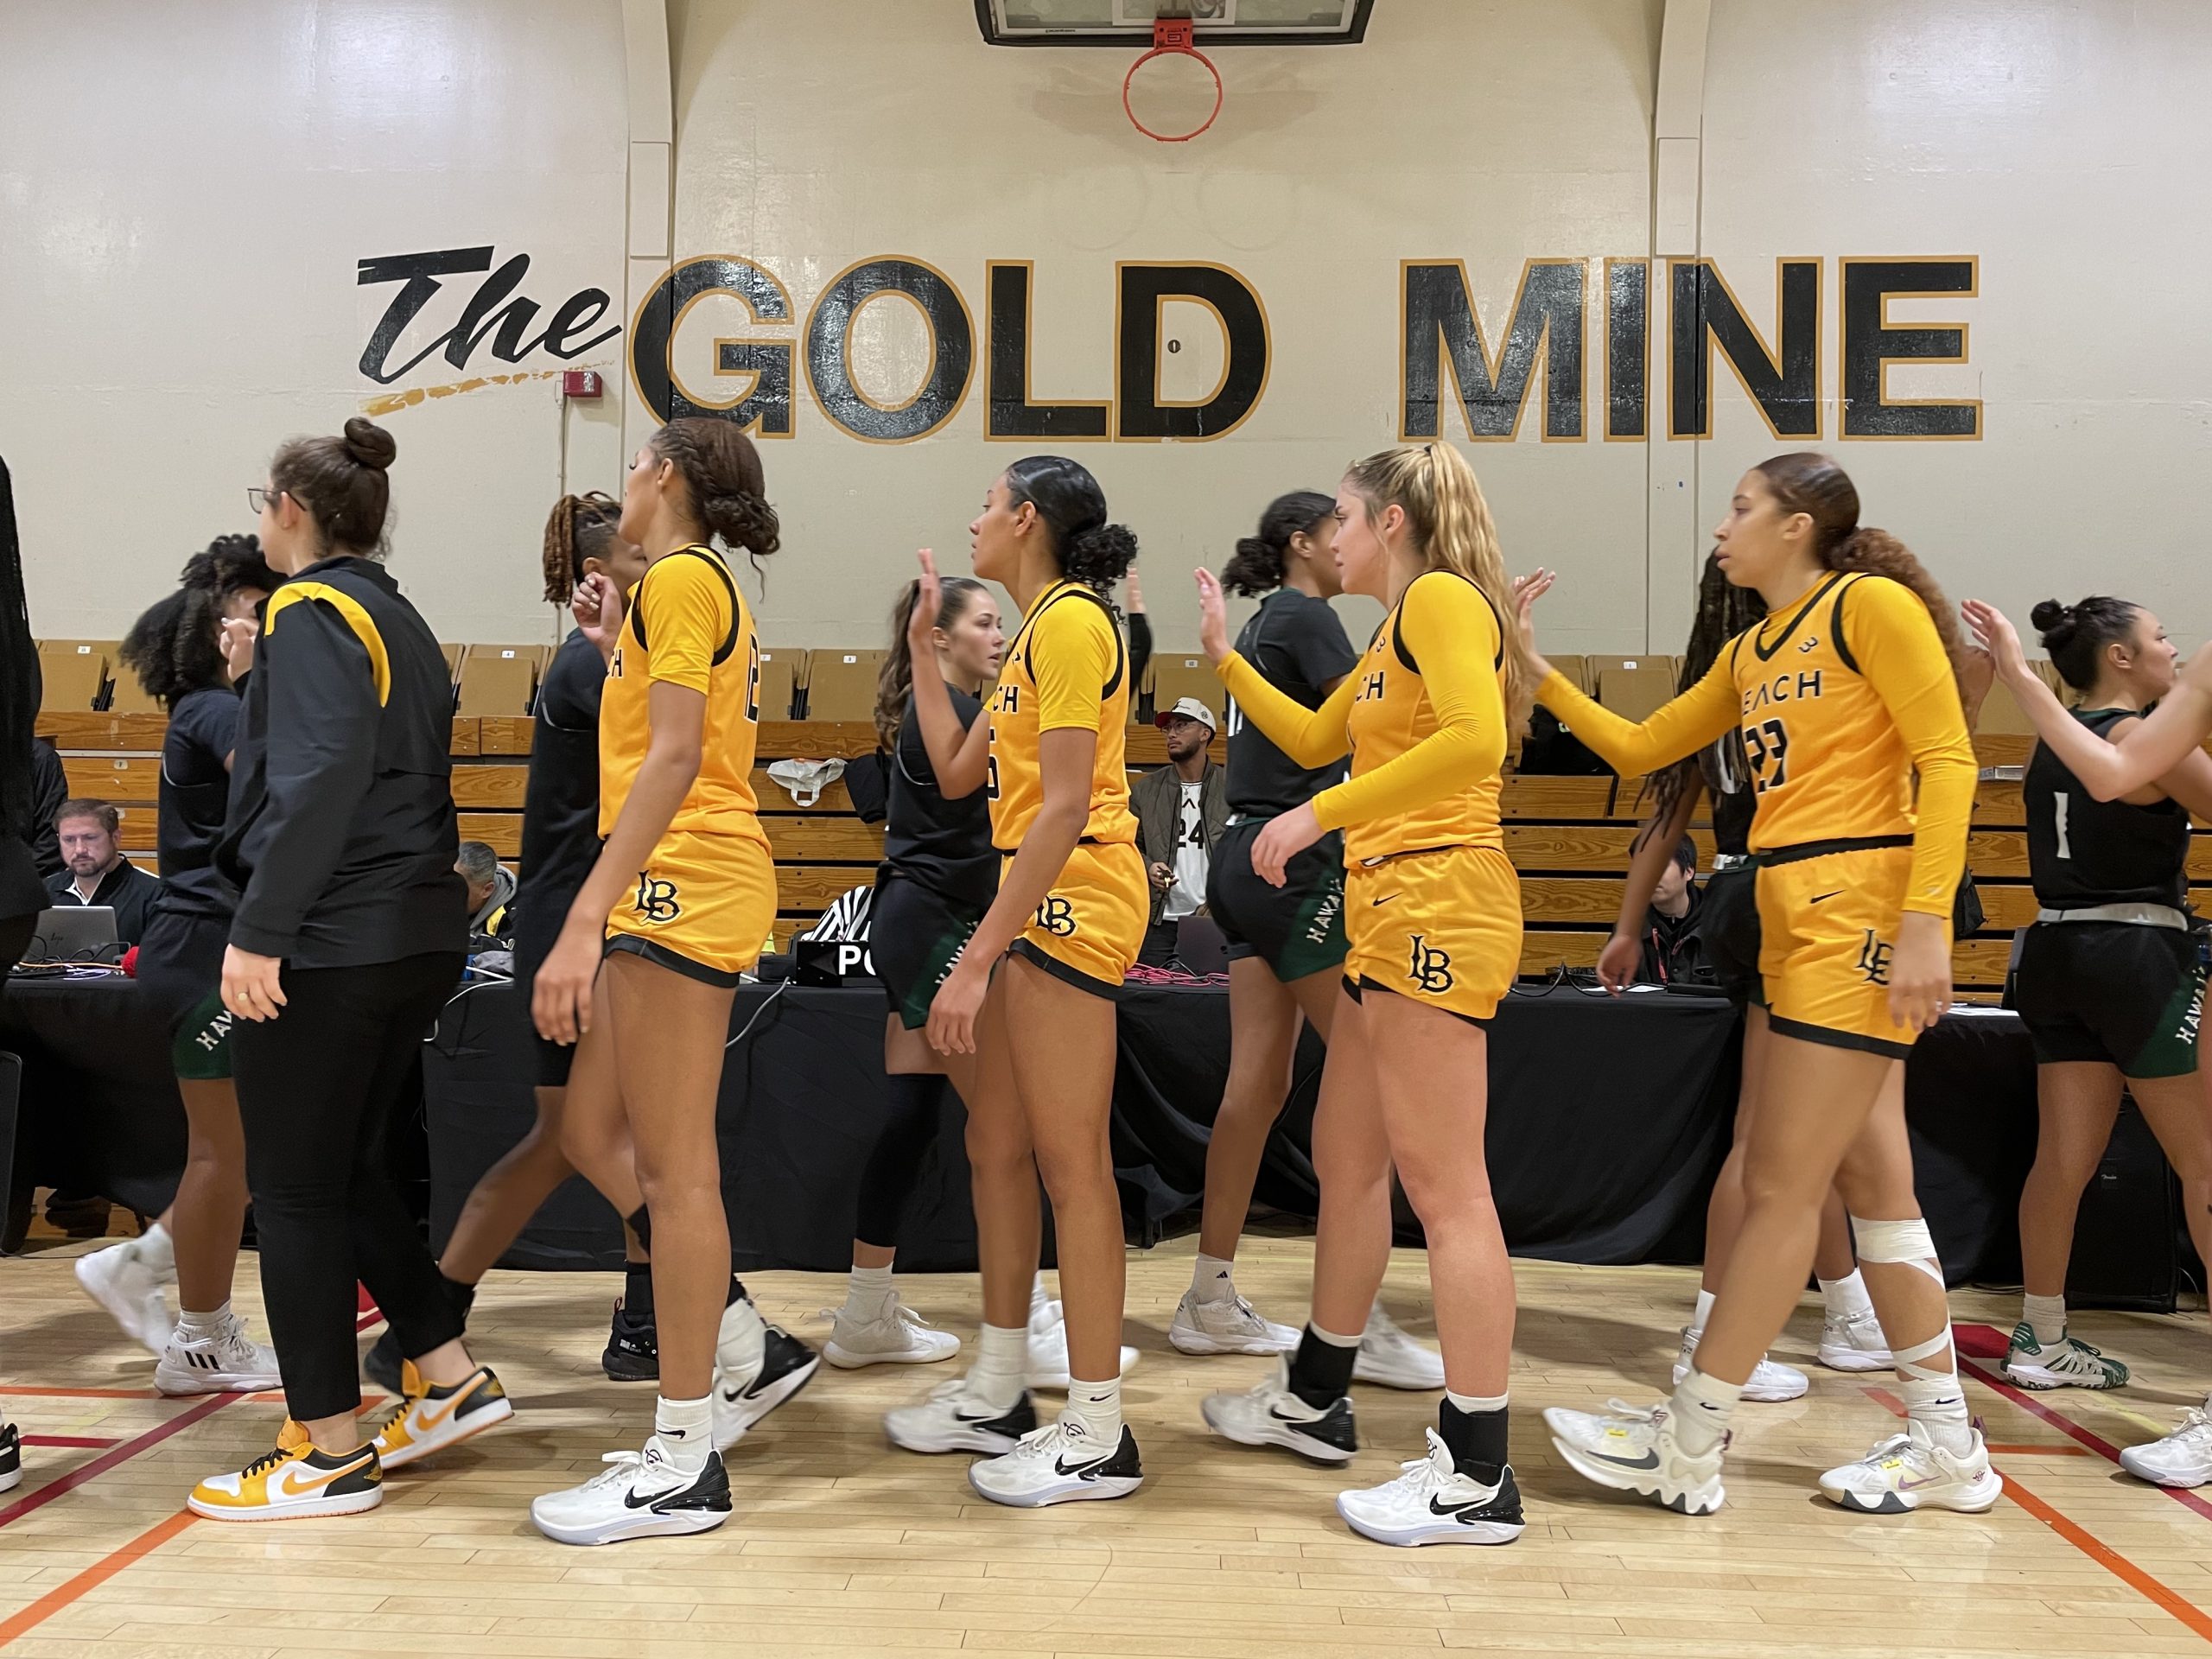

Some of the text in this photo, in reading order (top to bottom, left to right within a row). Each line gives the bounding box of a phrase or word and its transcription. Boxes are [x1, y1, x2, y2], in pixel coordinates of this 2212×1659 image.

[357, 245, 1983, 443] The GOLD MINE
[2053, 791, 2071, 859] 1
[633, 869, 680, 922] LB
[1408, 935, 1454, 993] LB
